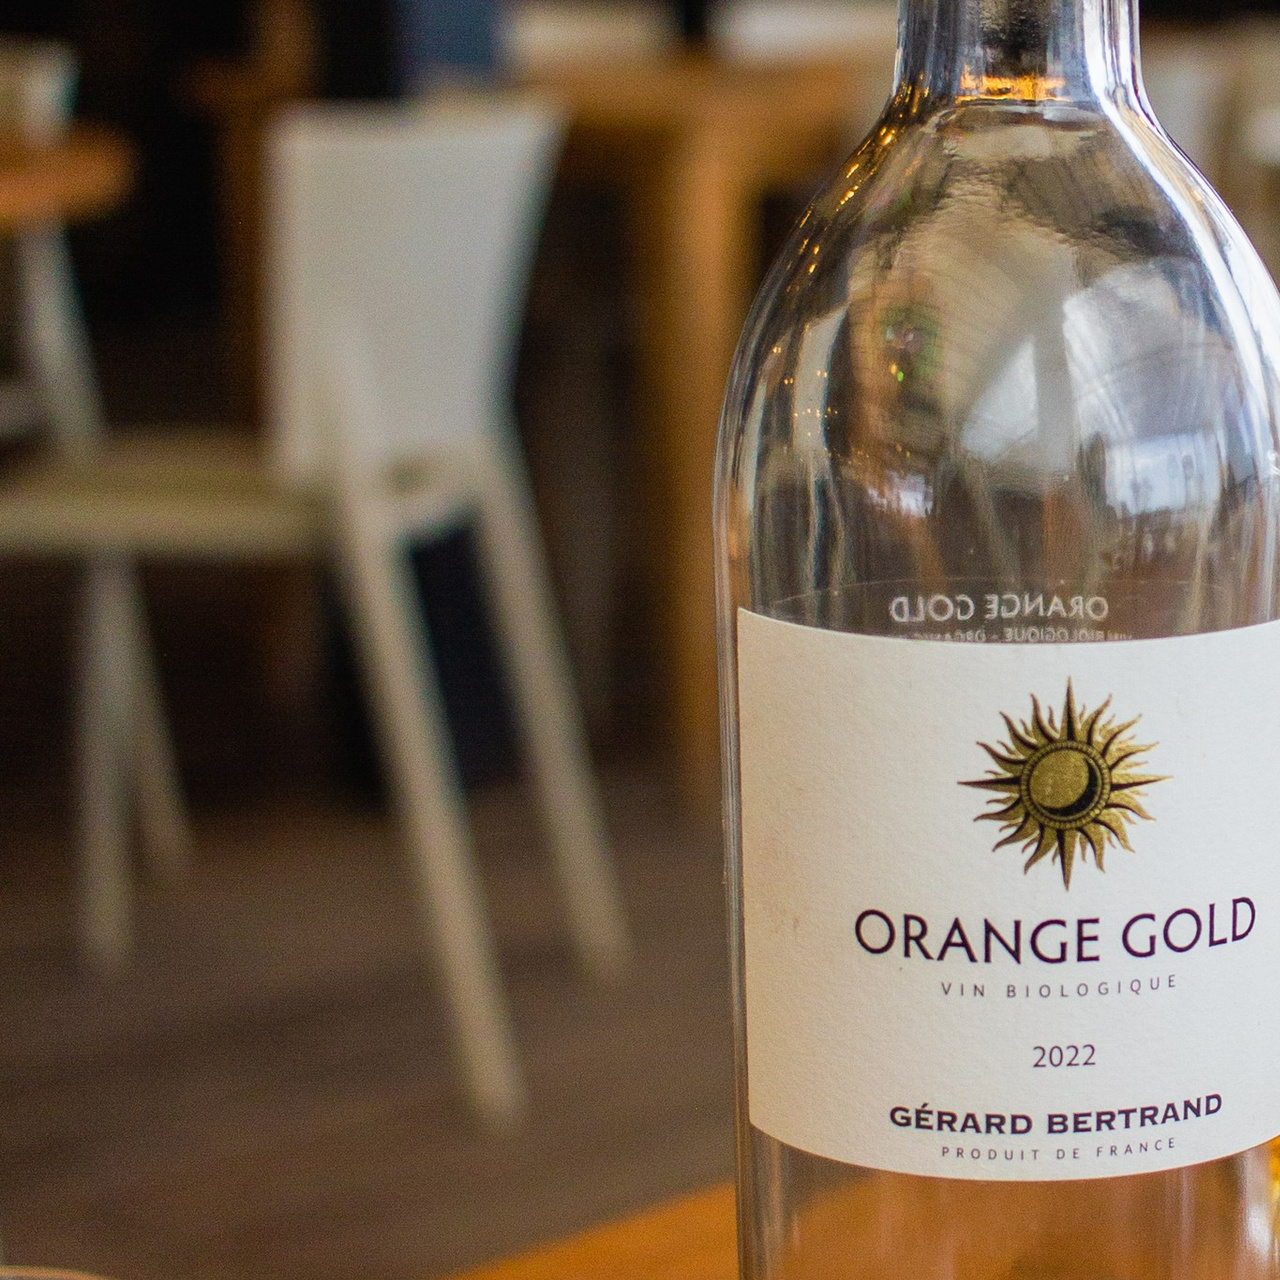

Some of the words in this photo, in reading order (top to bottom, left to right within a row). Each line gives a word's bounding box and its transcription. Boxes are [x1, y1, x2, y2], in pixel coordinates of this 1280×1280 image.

[854, 909, 1100, 965] ORANGE
[1121, 897, 1256, 958] GOLD
[941, 983, 984, 997] VIN
[1007, 975, 1175, 998] BIOLOGIQUE
[1033, 1044, 1095, 1068] 2022
[889, 1102, 1032, 1135] GÉRARD
[1047, 1094, 1222, 1134] BERTRAND
[942, 1147, 1038, 1160] PRODUIT
[1057, 1149, 1078, 1159] DE
[1097, 1138, 1174, 1157] FRANCE
